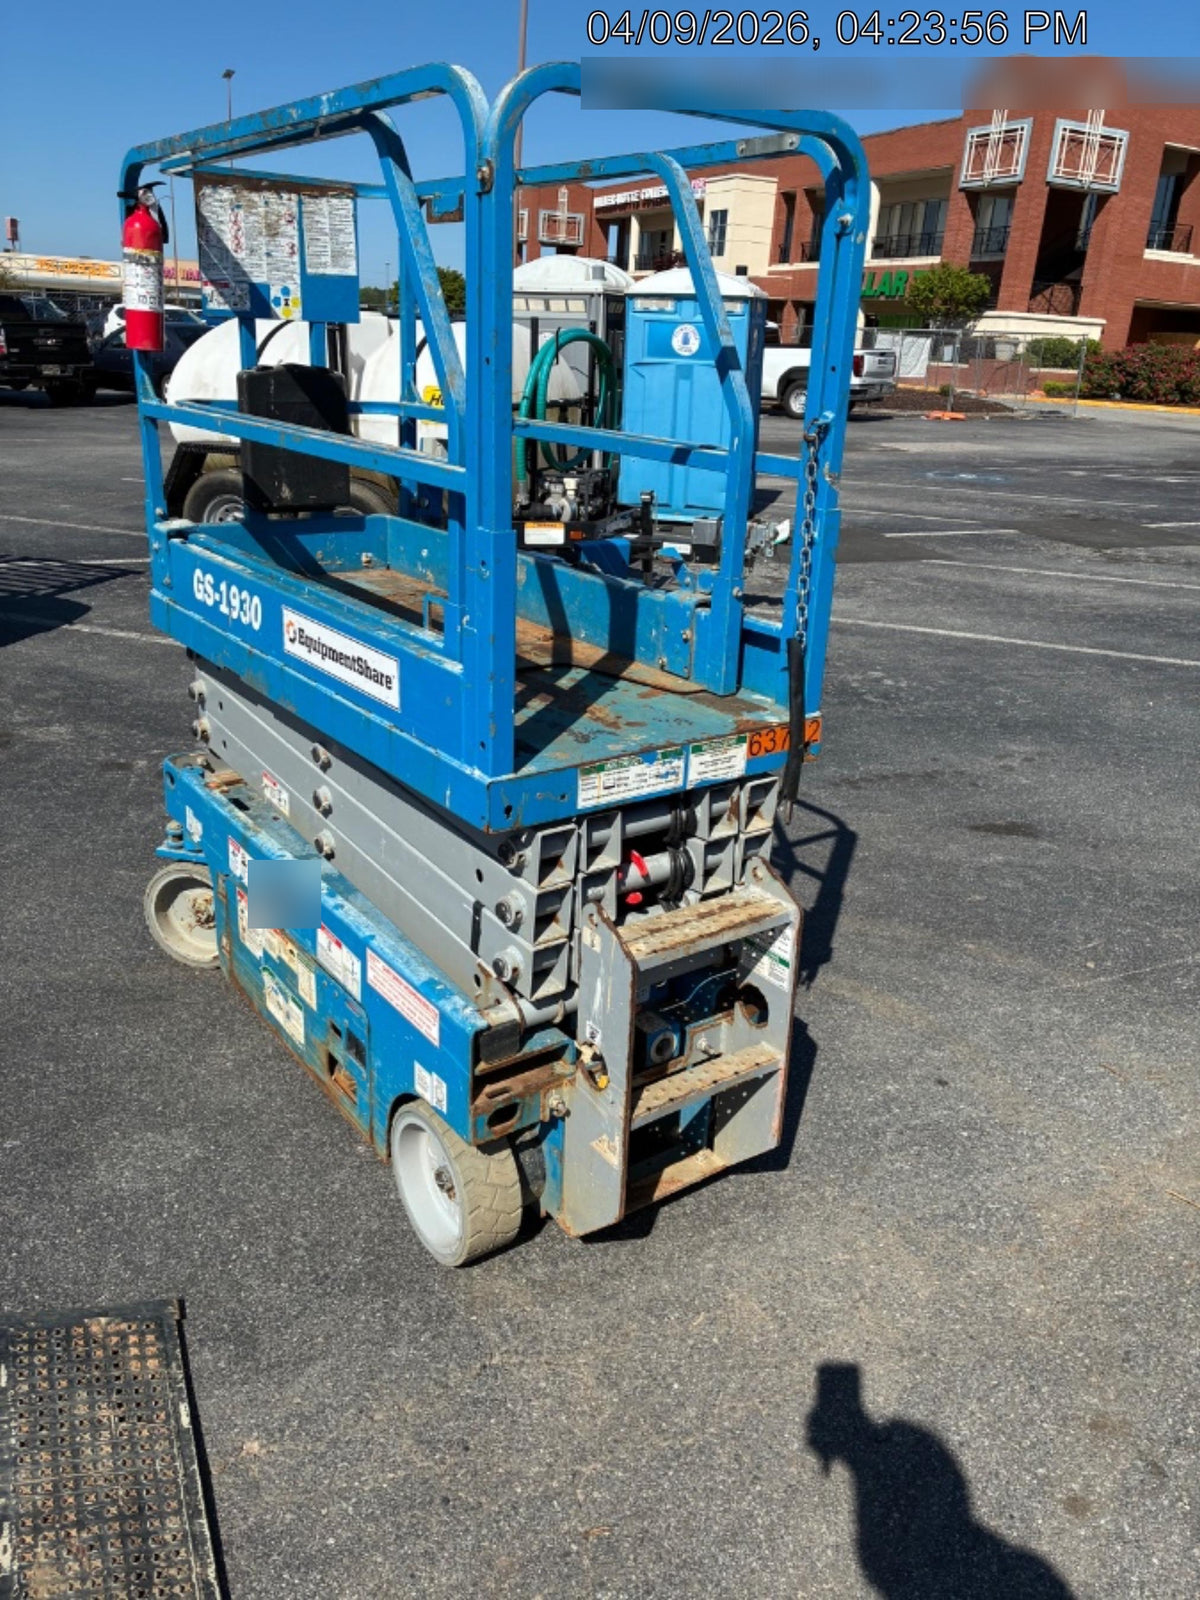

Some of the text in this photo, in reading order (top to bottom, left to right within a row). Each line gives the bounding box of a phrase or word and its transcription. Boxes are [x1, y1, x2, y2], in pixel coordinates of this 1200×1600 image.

[193, 568, 262, 631] GS-1930
[297, 626, 394, 690] EquipmentShare
[749, 719, 820, 756] 6372
